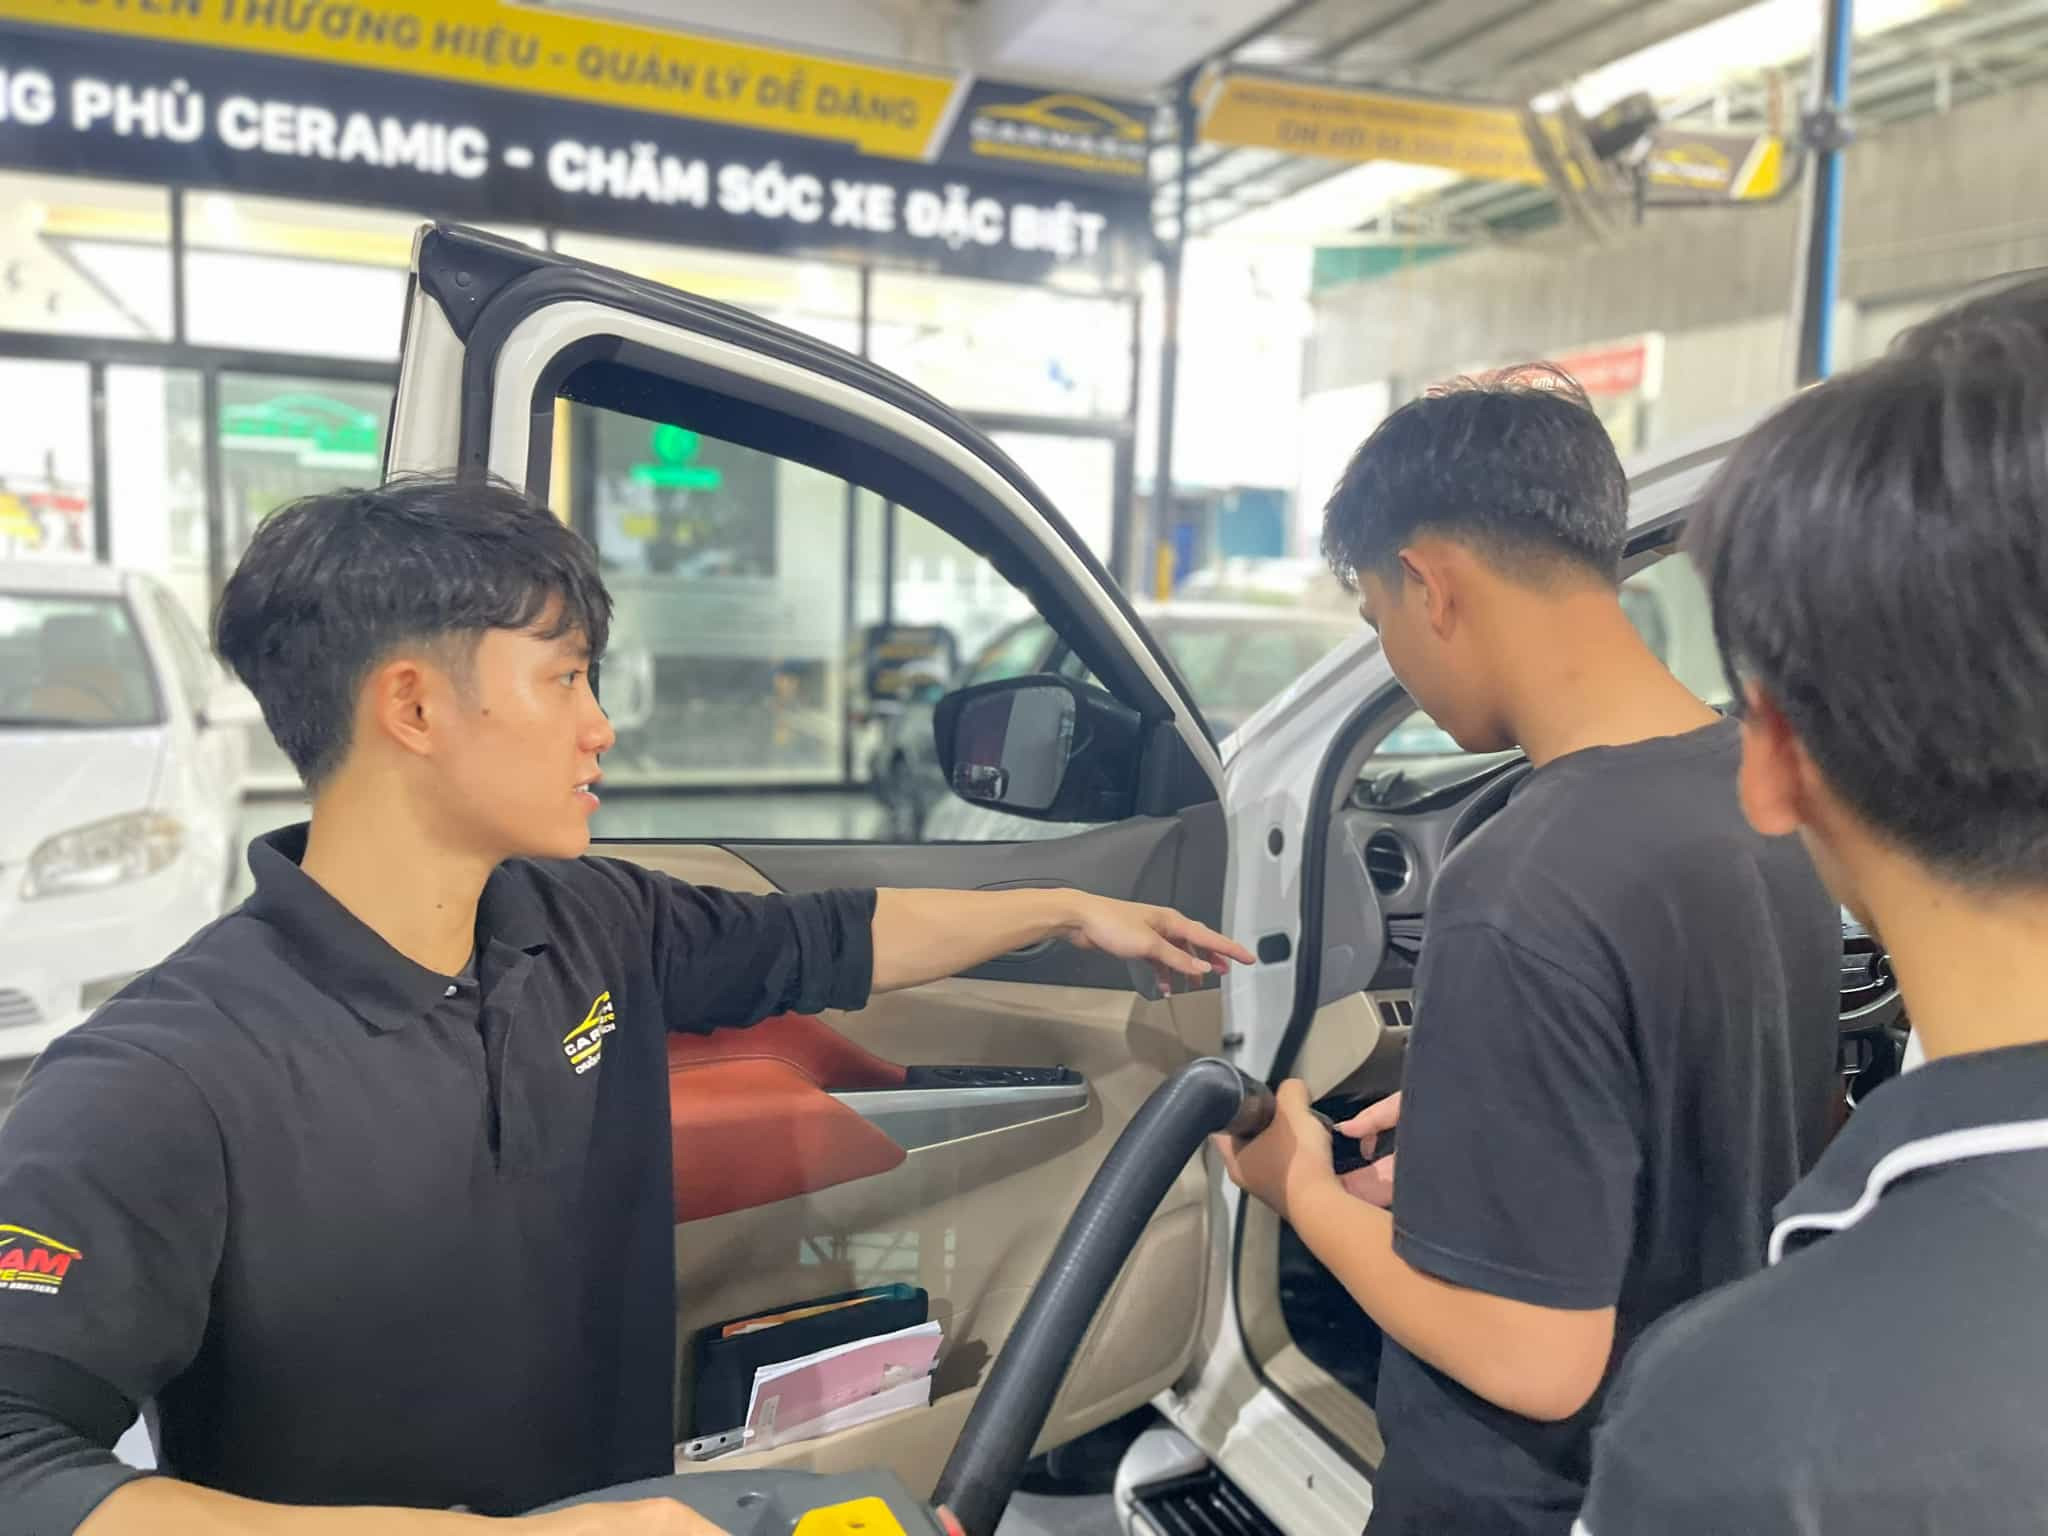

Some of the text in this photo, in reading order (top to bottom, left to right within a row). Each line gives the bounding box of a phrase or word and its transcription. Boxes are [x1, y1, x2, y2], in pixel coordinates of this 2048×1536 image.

[432, 22, 540, 68] HIỆU
[71, 77, 206, 143] PHỦ
[216, 95, 489, 180] CERAMIC
[547, 139, 710, 209] CHĂM
[717, 159, 824, 224] SÓC
[830, 178, 897, 233] XE
[904, 183, 1005, 250] ĐẶC
[1009, 199, 1107, 260] BIỆT
